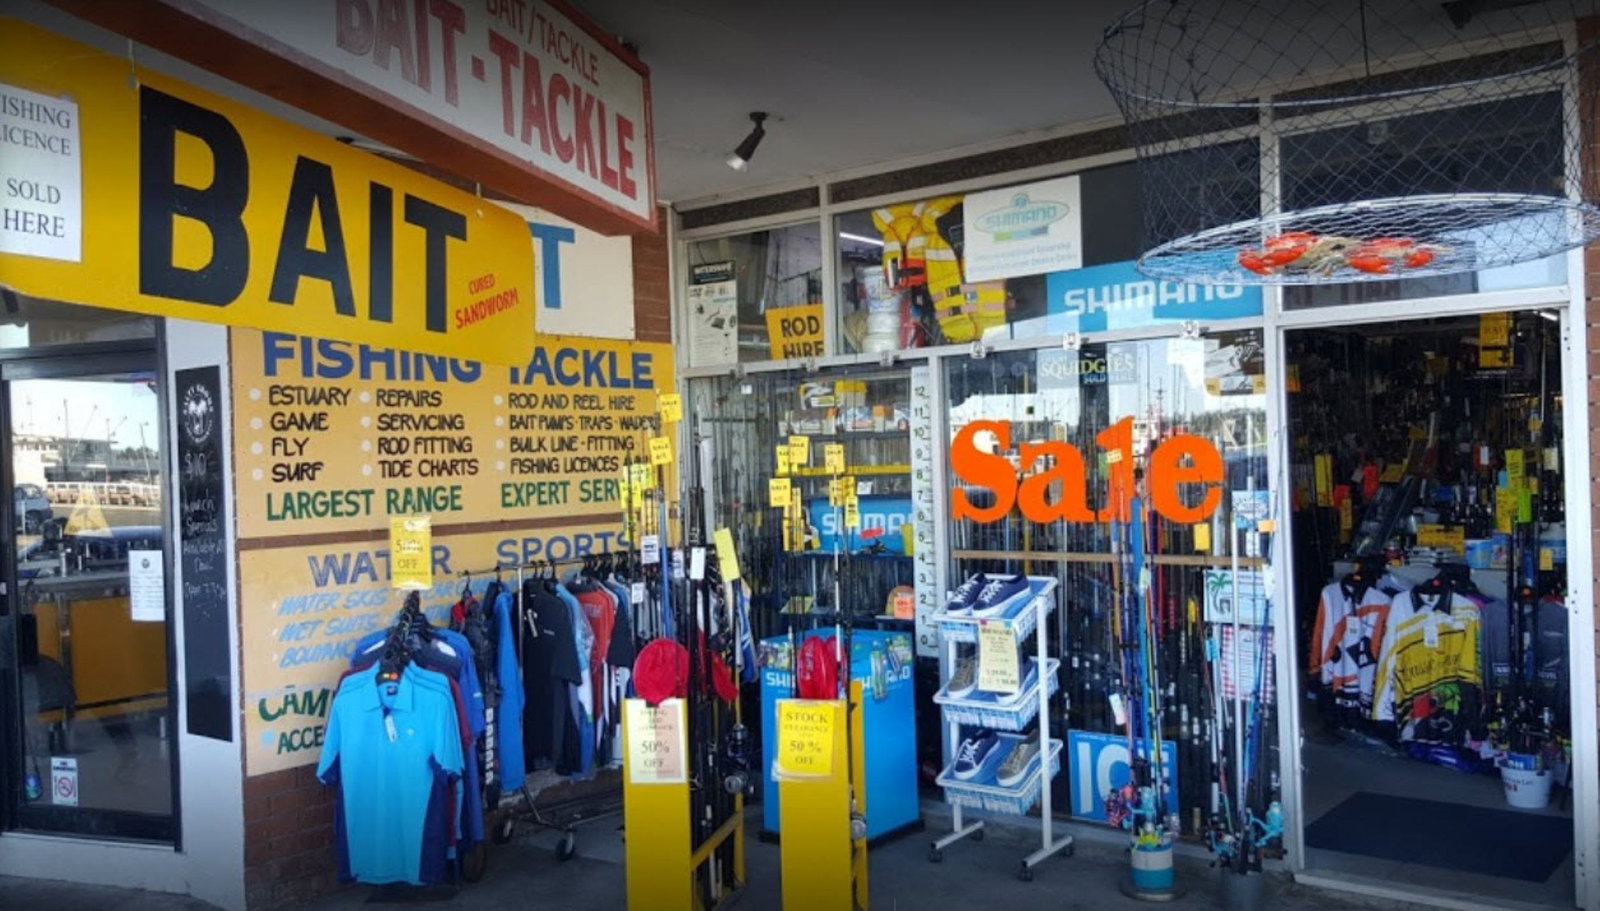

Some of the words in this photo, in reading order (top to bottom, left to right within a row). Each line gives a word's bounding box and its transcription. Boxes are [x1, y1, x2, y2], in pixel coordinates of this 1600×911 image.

[0, 95, 71, 129] ISHING
[6, 178, 61, 205] SOLD
[139, 84, 467, 333] BAIT
[3, 209, 66, 239] HERE
[468, 273, 496, 296] CURED
[1064, 270, 1244, 314] SHIMANO
[455, 287, 519, 330] SANDWORM
[780, 316, 820, 338] ROD
[263, 331, 481, 383] FISHING
[268, 385, 351, 406] ESTUARY
[376, 388, 443, 408] REPAIRS
[508, 392, 539, 410] ROD
[541, 393, 570, 410] AND
[573, 394, 604, 410] REEL
[609, 395, 636, 411] HIRE
[270, 412, 329, 431] GAME
[377, 413, 465, 431] SERVICING
[509, 414, 538, 431] BAIT
[539, 415, 574, 431] PUMPS
[579, 415, 613, 431] TRAPS
[271, 437, 309, 456] FLY
[378, 437, 409, 455] ROD
[414, 436, 472, 454] FITTING
[510, 436, 550, 453] BULK
[551, 436, 578, 451] LINE
[587, 435, 635, 451] FITTING
[271, 462, 324, 482] SURF
[378, 460, 412, 478] TIDE
[418, 458, 479, 477] CHARTS
[510, 457, 560, 474] FISHING
[564, 456, 619, 474] LICENCES
[951, 415, 1224, 523] Sale
[267, 489, 375, 521] LARGEST
[386, 485, 463, 515] RANGE
[501, 481, 570, 508] EXPERT
[308, 545, 452, 588] WATR
[277, 591, 341, 615] WATER
[279, 619, 323, 642] WET
[786, 711, 828, 723] STOCK
